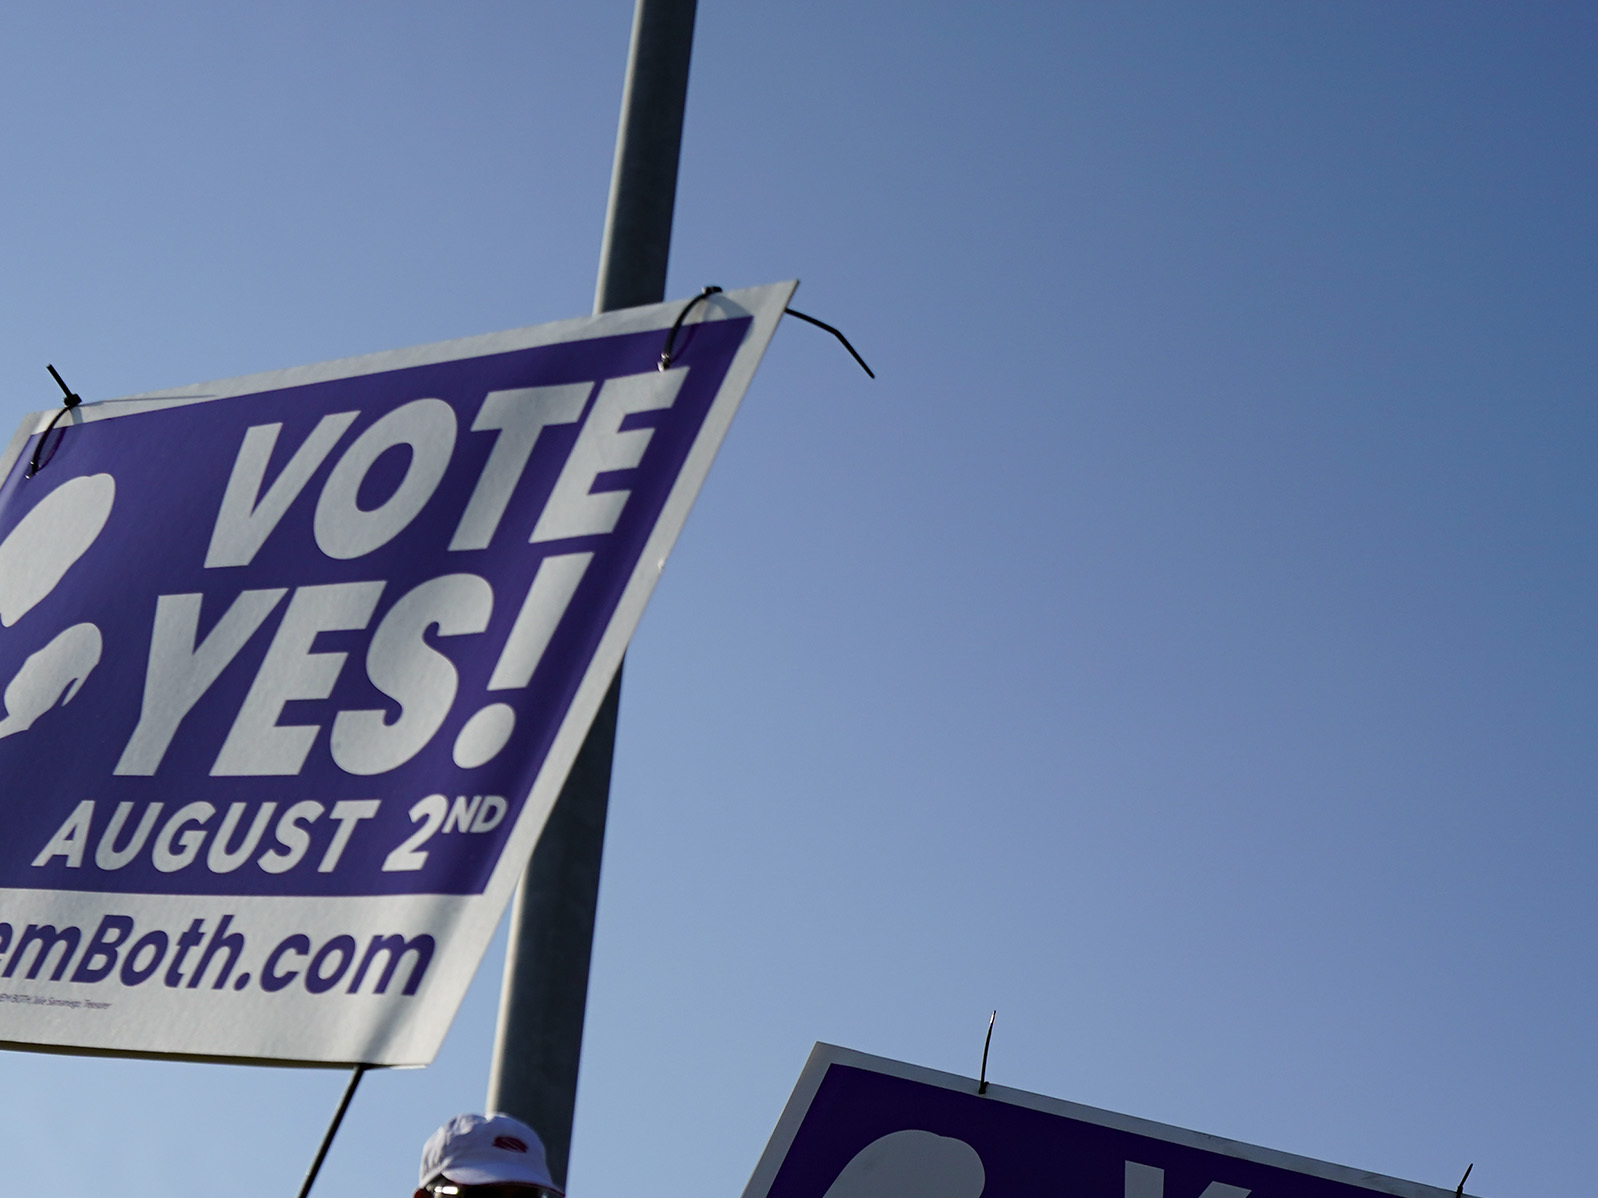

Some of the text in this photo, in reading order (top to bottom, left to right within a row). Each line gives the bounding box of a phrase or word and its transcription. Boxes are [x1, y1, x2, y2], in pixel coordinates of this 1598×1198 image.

[203, 366, 690, 569] VOTE
[113, 552, 595, 776] YES!
[32, 794, 508, 875] AUGUST 2ND
